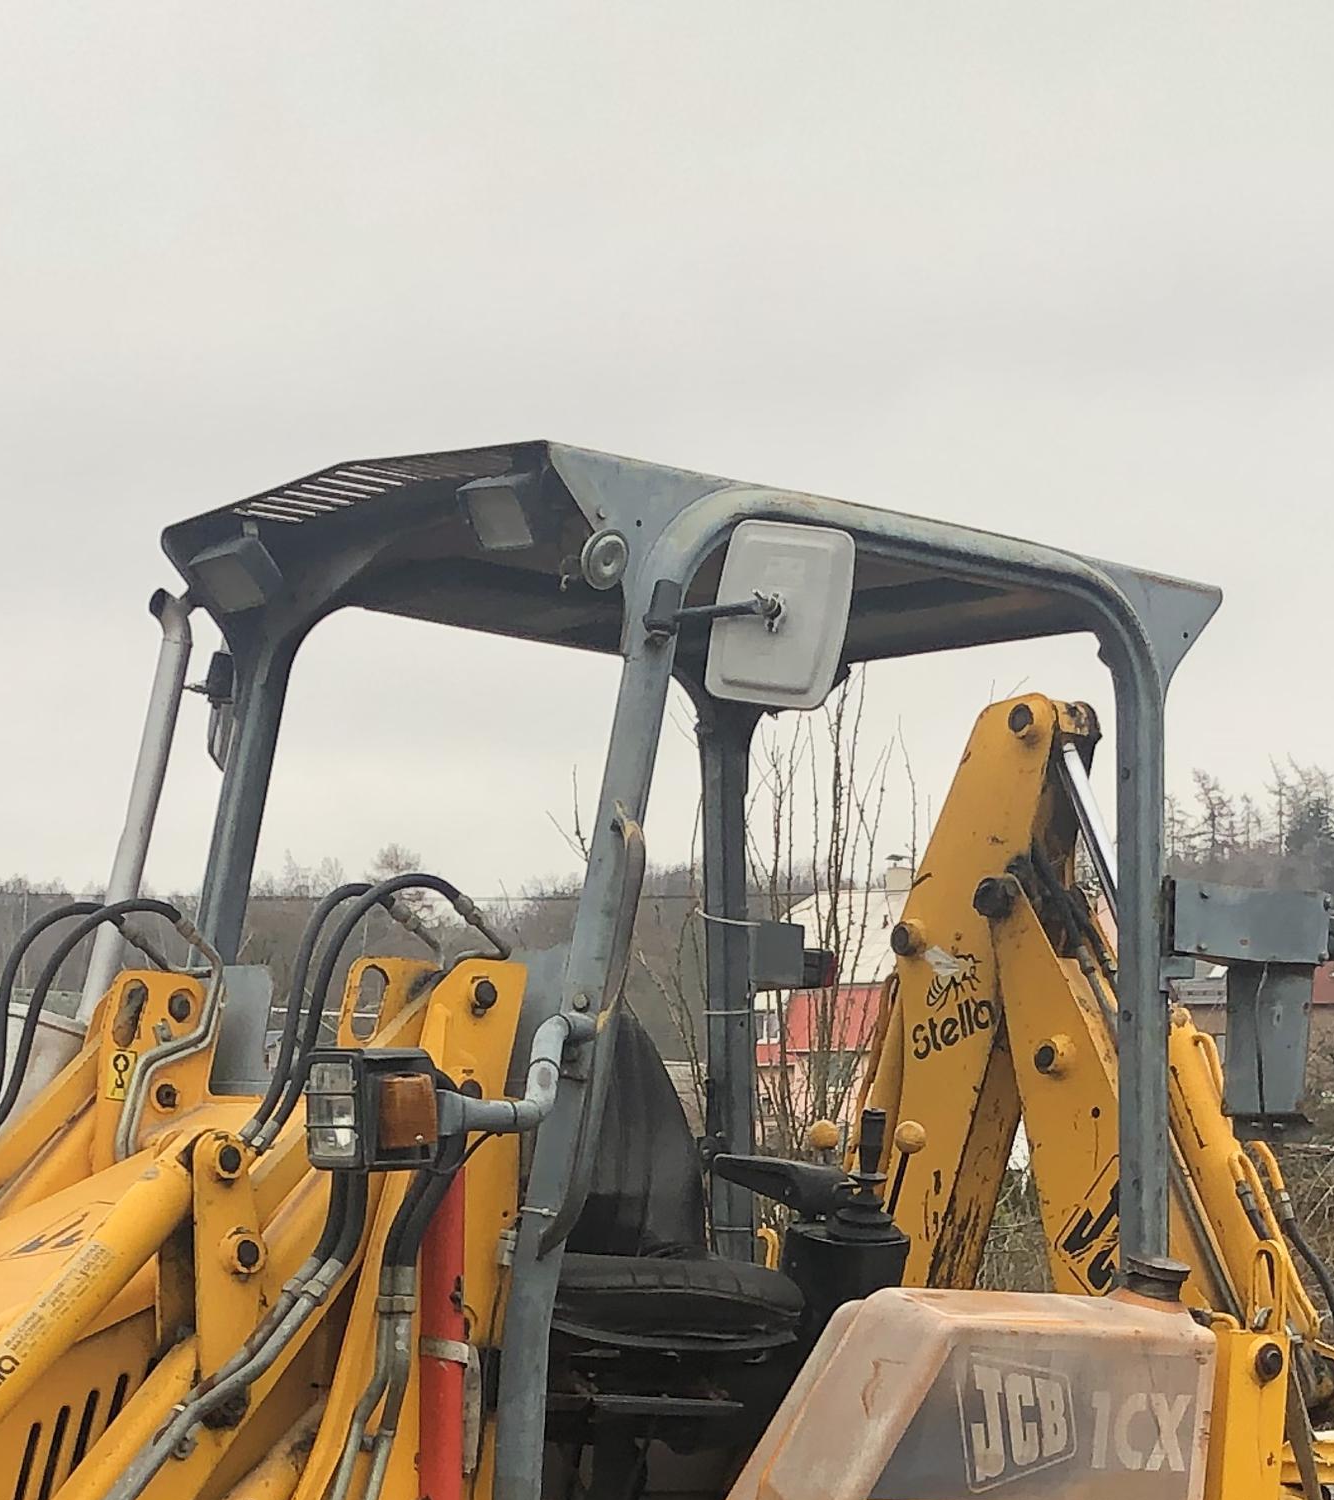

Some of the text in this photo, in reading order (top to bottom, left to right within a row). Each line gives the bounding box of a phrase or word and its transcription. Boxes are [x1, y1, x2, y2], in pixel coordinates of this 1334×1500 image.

[912, 998, 998, 1060] Stella
[970, 1363, 1193, 1483] JCB 1CX
